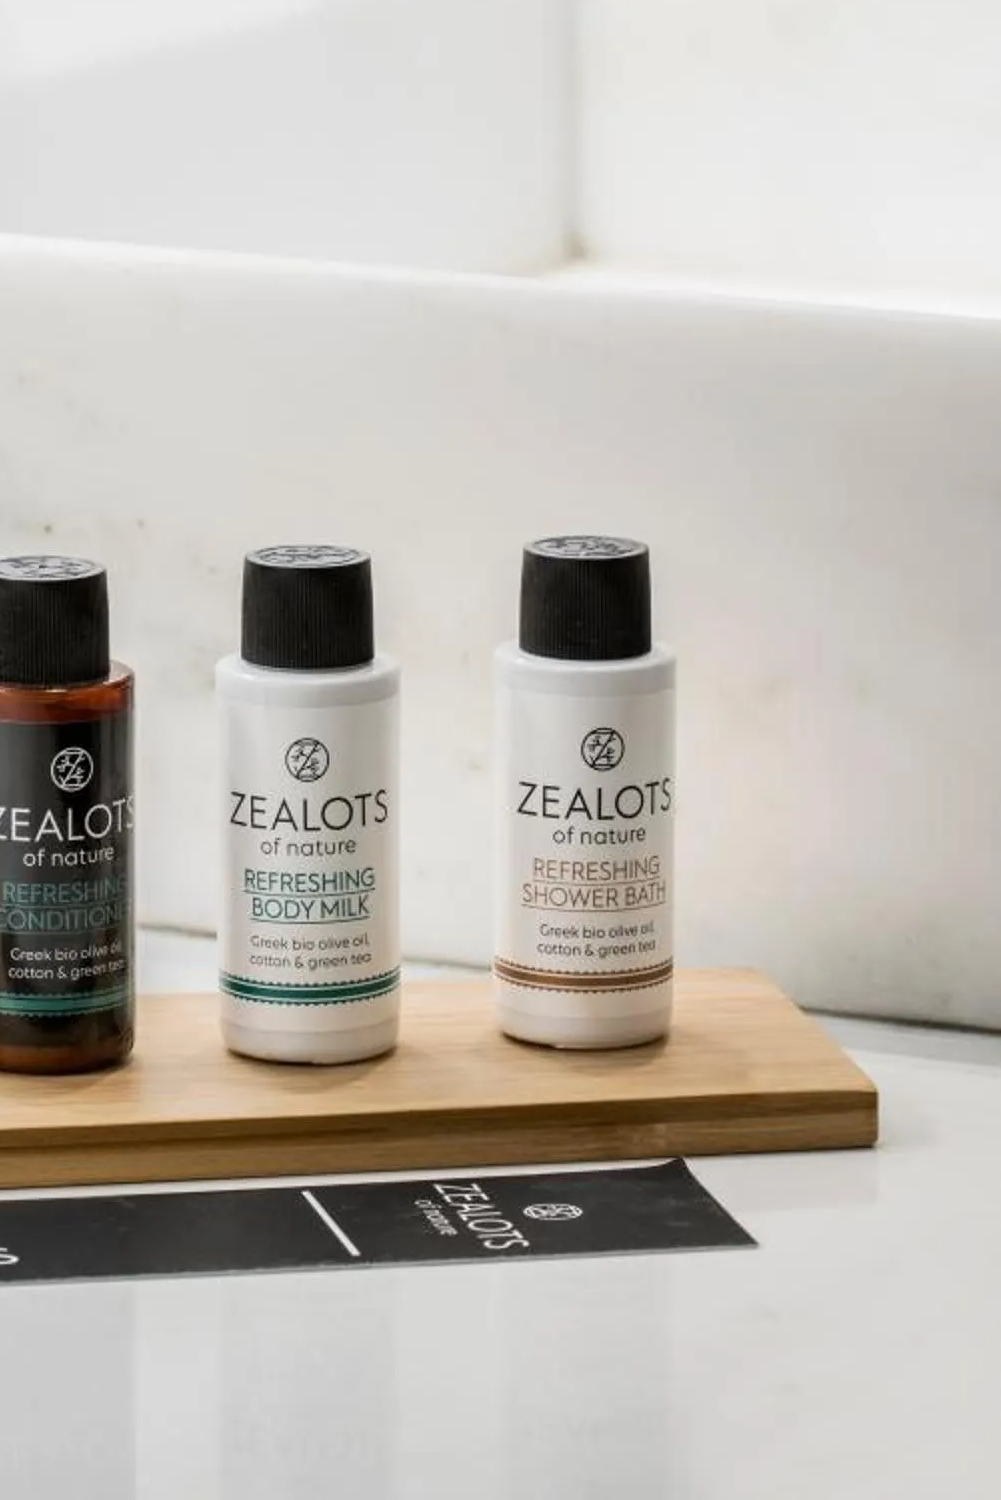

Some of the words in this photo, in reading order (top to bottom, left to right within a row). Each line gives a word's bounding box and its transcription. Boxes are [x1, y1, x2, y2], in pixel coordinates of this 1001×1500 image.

[517, 777, 672, 820] ZEALOTS
[230, 789, 388, 832] ZEALOTS
[552, 826, 576, 844] of
[580, 826, 646, 845] nature
[22, 848, 46, 867] of
[51, 847, 114, 866] nature
[260, 837, 282, 855] of
[286, 838, 357, 857] nature
[534, 855, 661, 881] REFRESHING
[244, 867, 375, 893] REFRESHING
[522, 882, 619, 908] SHOWER
[625, 878, 667, 906] BATH
[252, 897, 316, 920] BODY
[320, 894, 370, 918] MILK
[539, 923, 580, 938] Greek
[582, 925, 606, 939] bio
[608, 924, 638, 939] olive
[250, 934, 289, 949] Greek
[292, 936, 315, 951] bio
[318, 934, 350, 950] olive
[536, 941, 581, 956] cotton
[584, 943, 595, 957] &
[598, 944, 636, 959] green
[638, 939, 656, 953] tea
[10, 947, 51, 961] Greek
[54, 948, 78, 961] bio
[249, 954, 290, 968] cotton
[294, 955, 304, 969] &
[308, 956, 347, 971] green
[351, 952, 372, 966] tea
[8, 967, 54, 980] cotton
[58, 965, 68, 979] &
[70, 963, 106, 981] green
[433, 1183, 530, 1249] ZEALOTS
